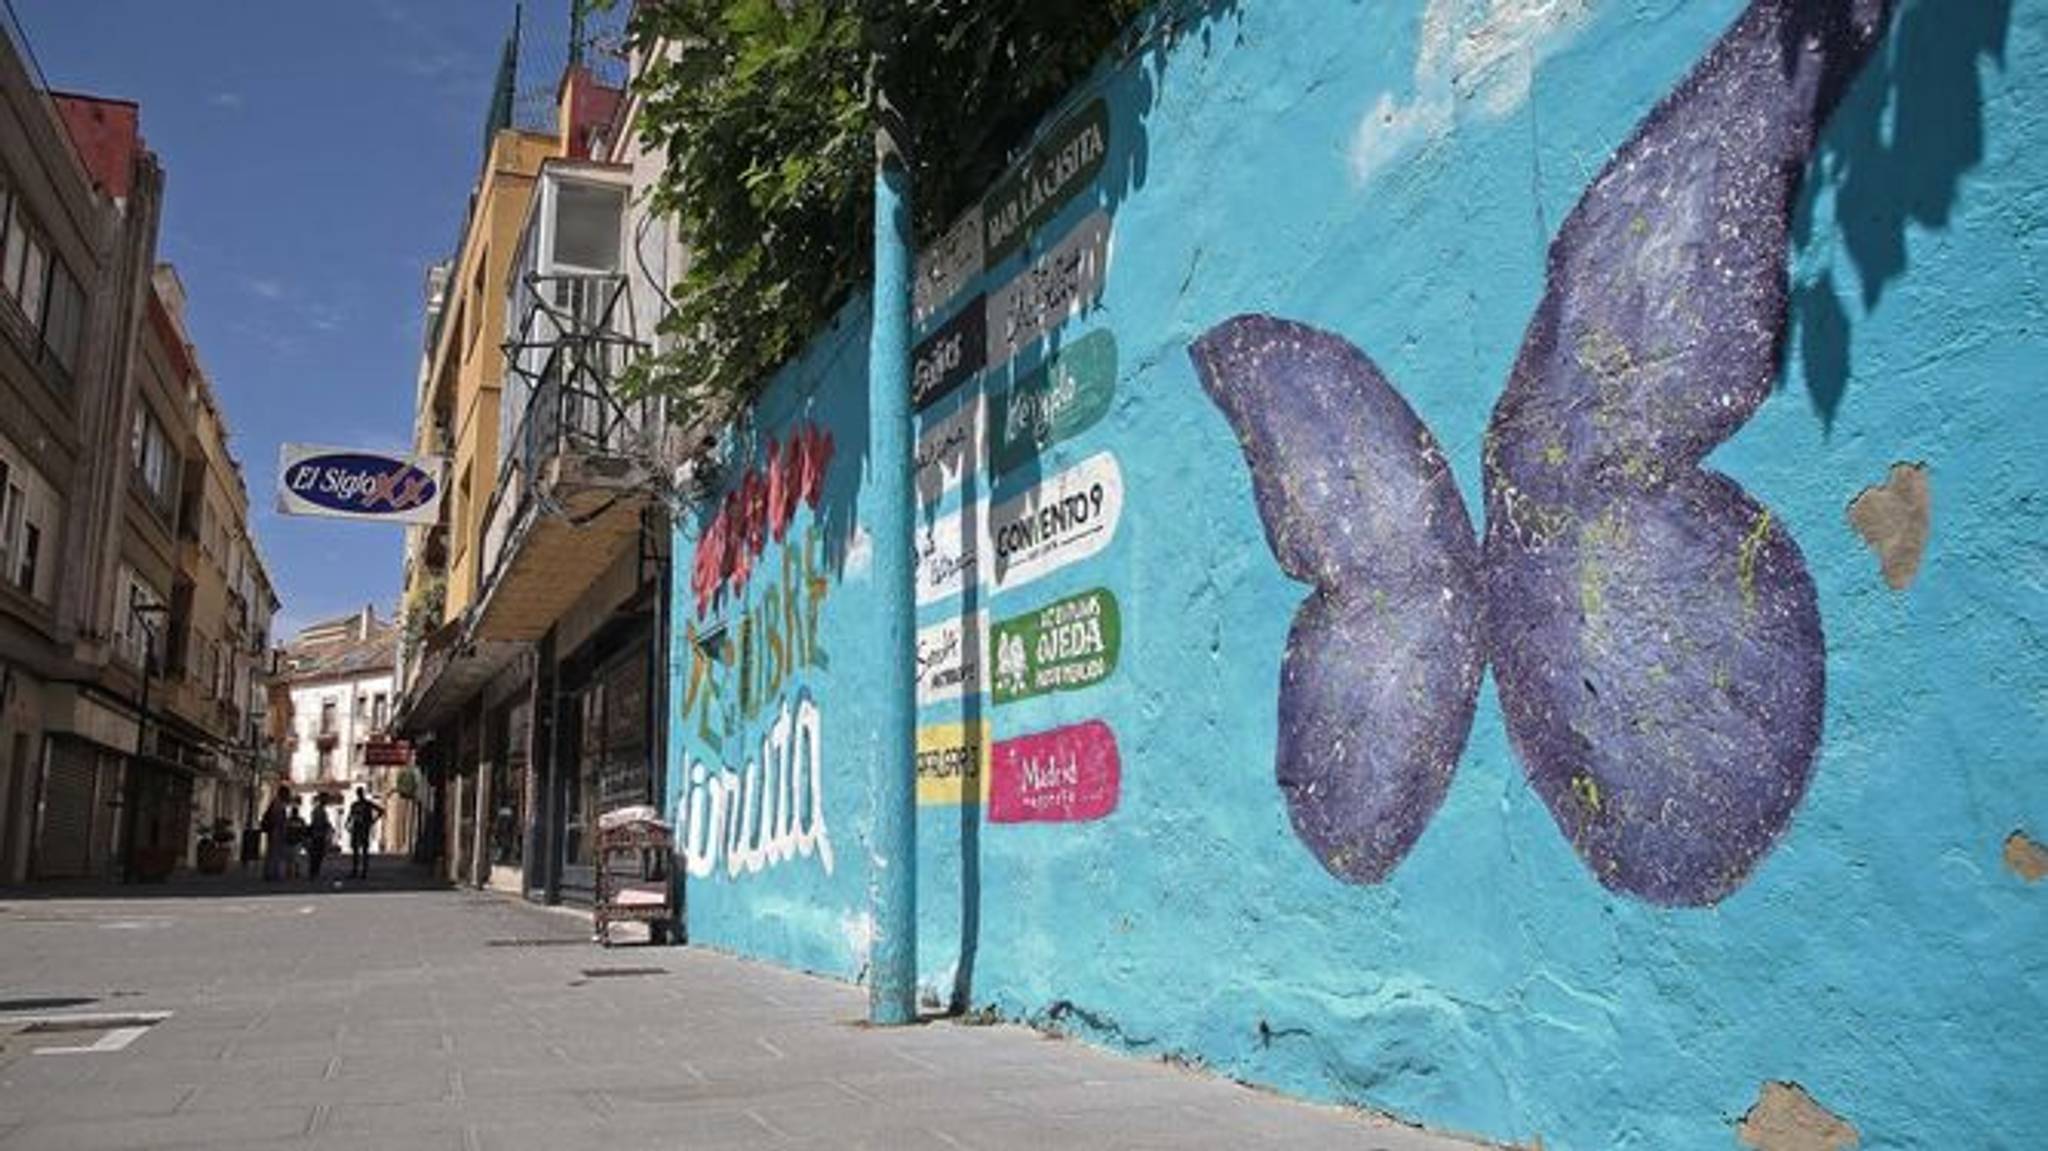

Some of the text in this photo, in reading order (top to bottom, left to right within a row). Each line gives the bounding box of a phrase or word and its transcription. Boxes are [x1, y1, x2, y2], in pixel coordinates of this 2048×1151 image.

[292, 466, 320, 490] El
[320, 467, 378, 498] Siglo
[1090, 482, 1104, 516] 9
[1036, 618, 1105, 664] OJEDA
